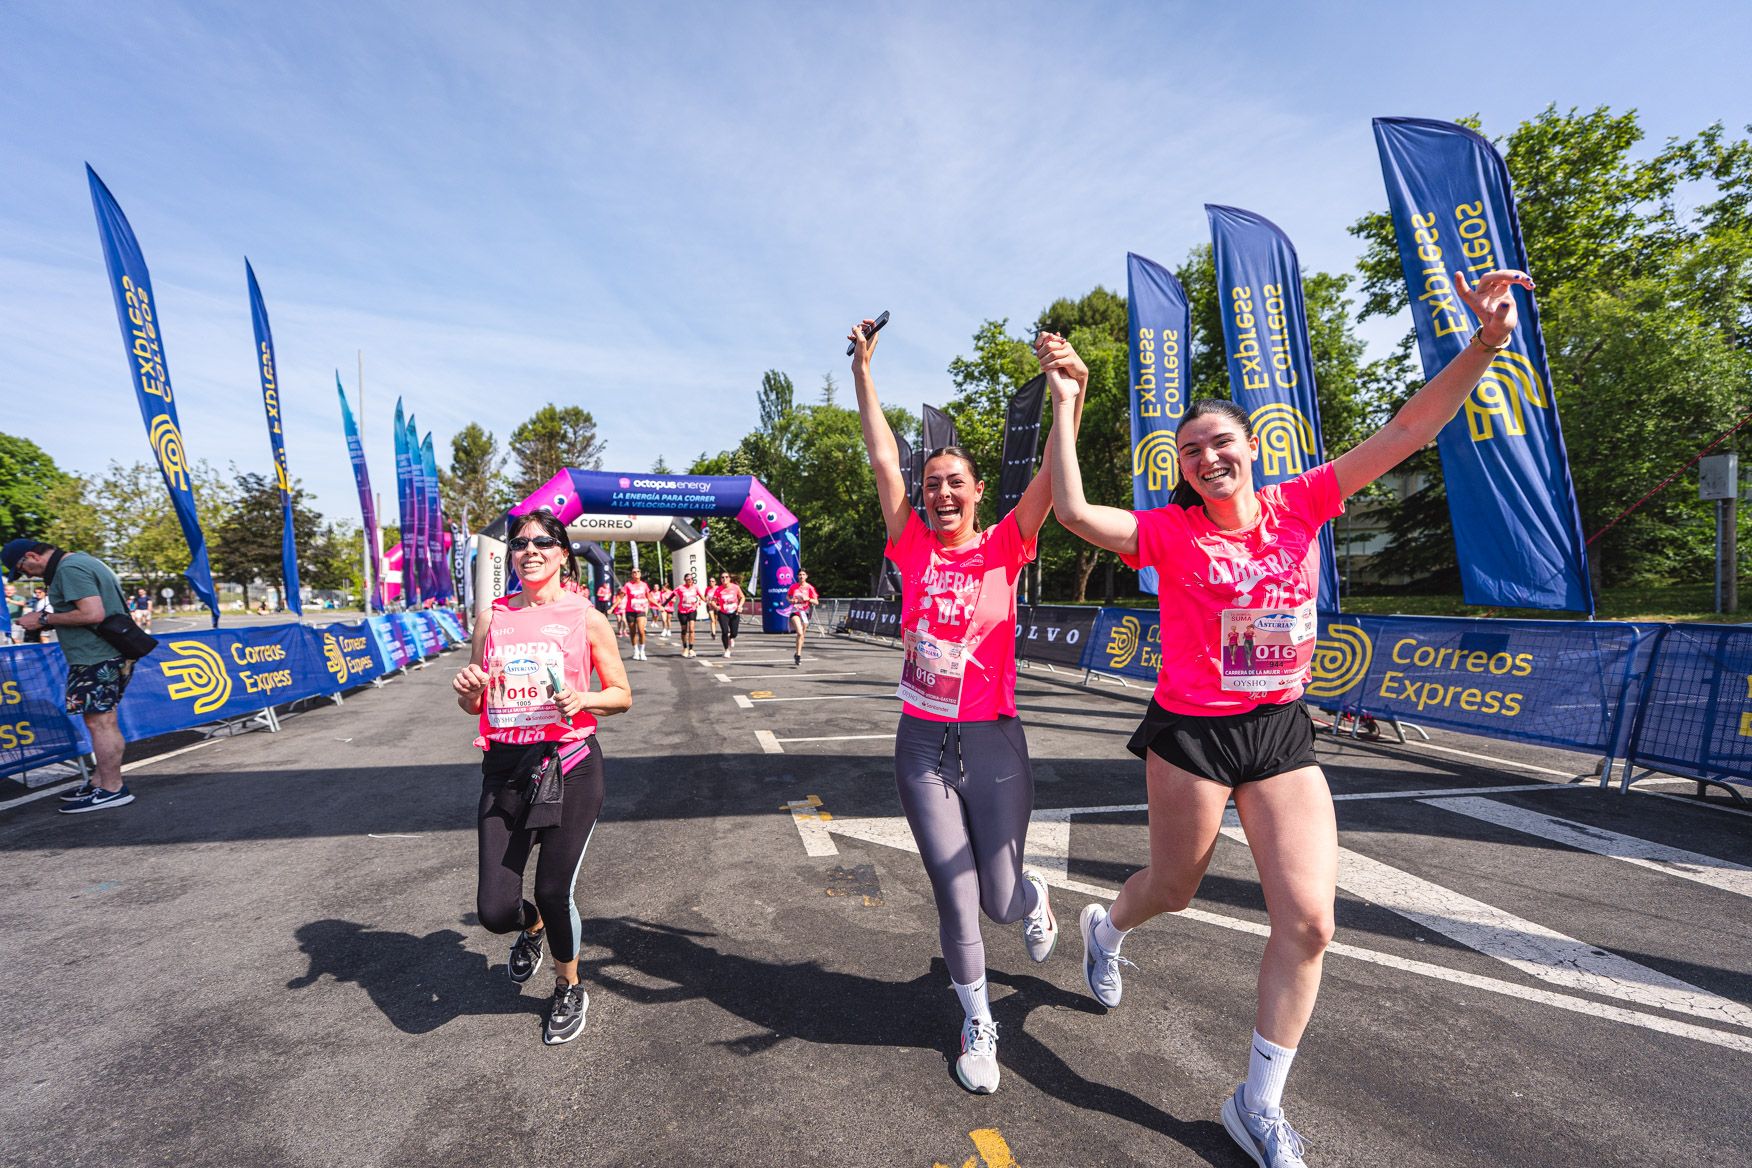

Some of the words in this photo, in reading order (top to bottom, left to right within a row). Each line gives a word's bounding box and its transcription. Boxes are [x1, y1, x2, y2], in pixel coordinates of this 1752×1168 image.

[625, 492, 660, 500] ENERGÍA
[661, 494, 683, 502] PARA
[580, 519, 633, 529] CORREO
[689, 554, 696, 565] EL
[493, 556, 502, 598] CORREO
[920, 565, 975, 592] ARRERA
[850, 609, 876, 621] VOLVO
[1015, 624, 1080, 644] OLVO
[231, 643, 286, 665] Correos
[488, 642, 559, 656] ARRERA
[1256, 646, 1296, 659] 016
[1392, 638, 1534, 676] Correos
[239, 669, 292, 695] Express
[917, 668, 936, 686] 016
[507, 687, 538, 699] 016
[1379, 671, 1524, 716] Express
